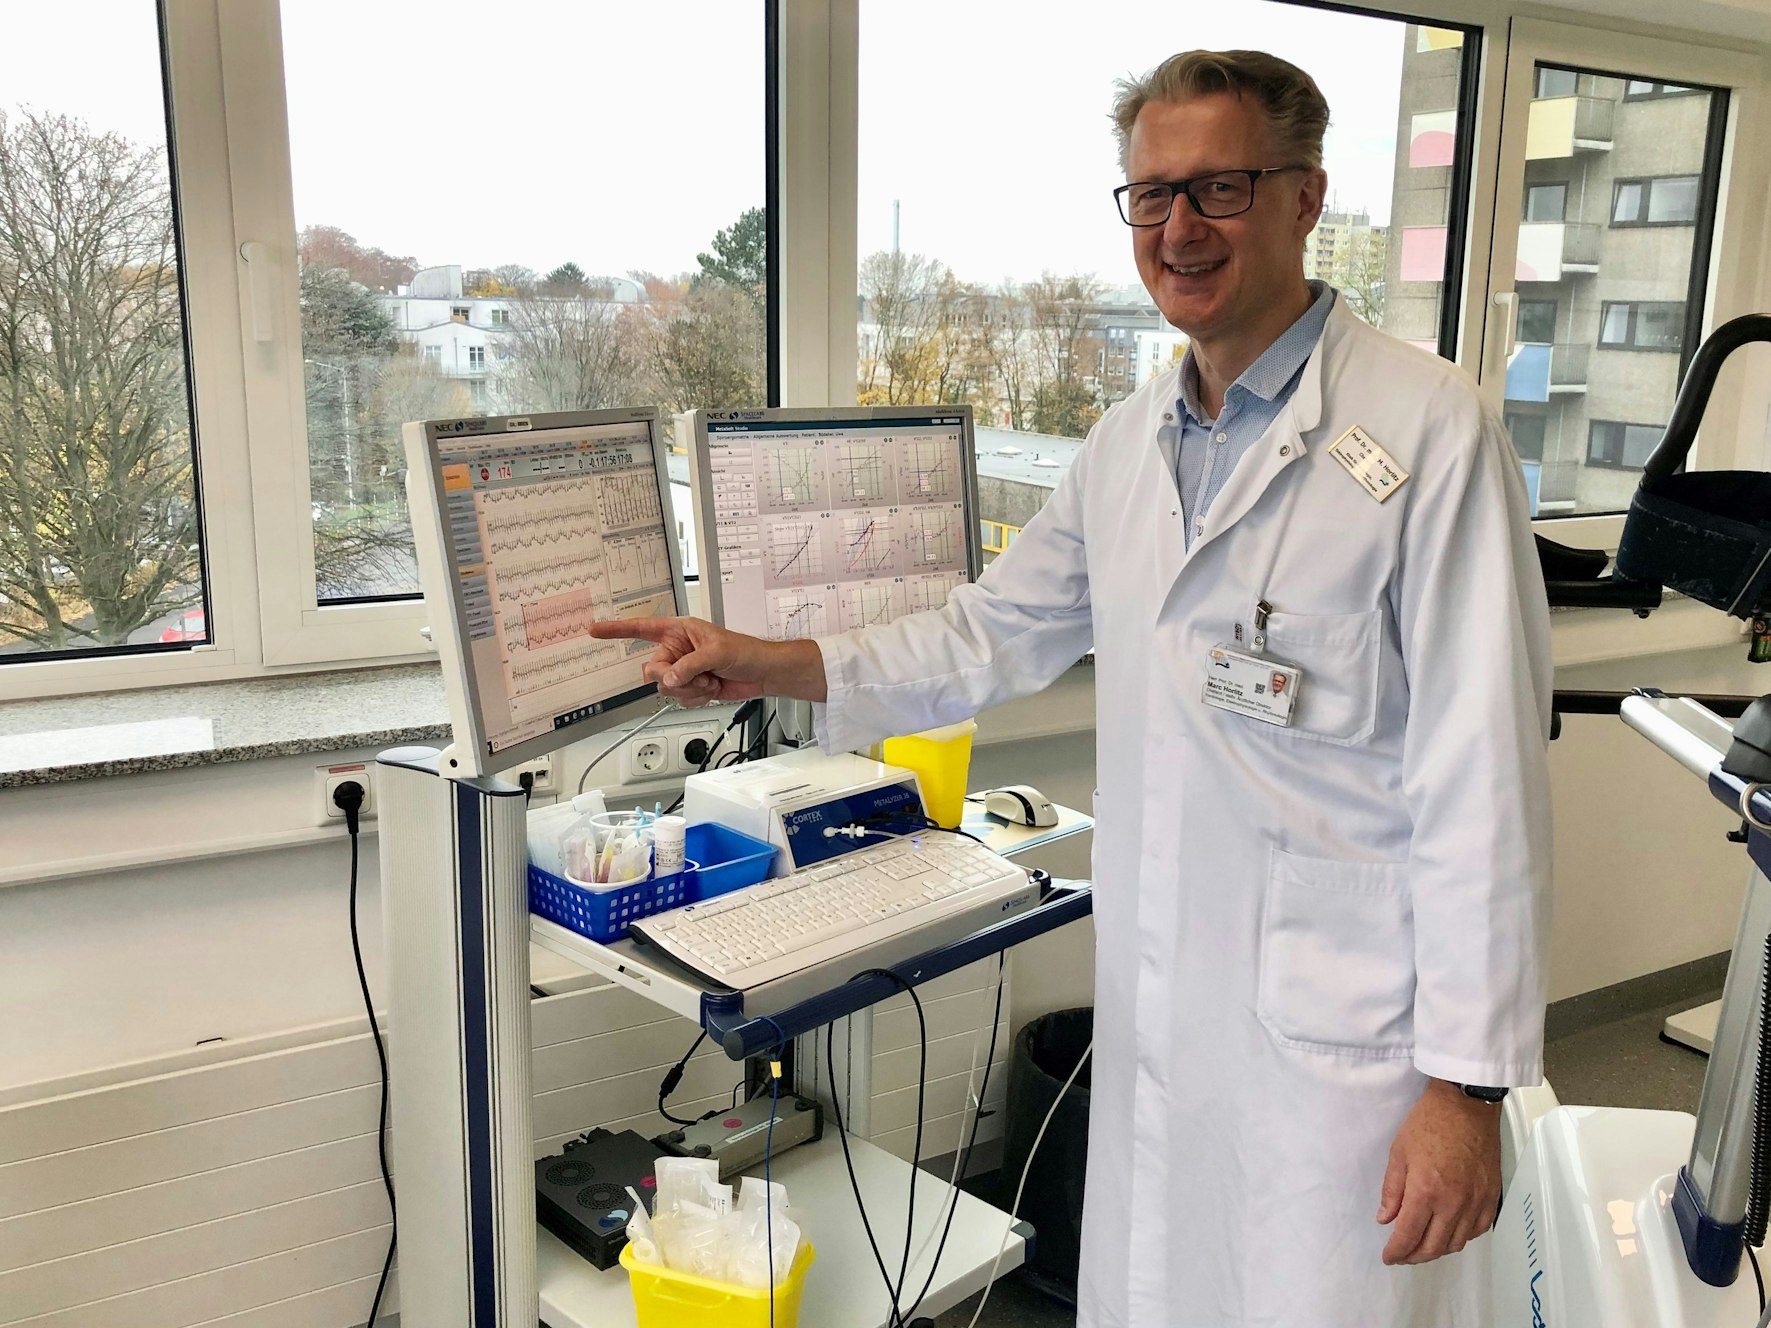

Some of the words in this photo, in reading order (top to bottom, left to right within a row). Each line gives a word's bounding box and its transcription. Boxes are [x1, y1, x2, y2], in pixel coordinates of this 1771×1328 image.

[707, 412, 726, 420] NEC
[434, 424, 454, 433] NEC
[601, 455, 617, 467] 17:56
[617, 453, 633, 465] 17:08
[498, 466, 512, 479] 174
[1384, 465, 1399, 481] Horlitz
[1207, 681, 1222, 691] Marc
[1223, 685, 1244, 697] Horlitz
[792, 809, 822, 825] CORTEX
